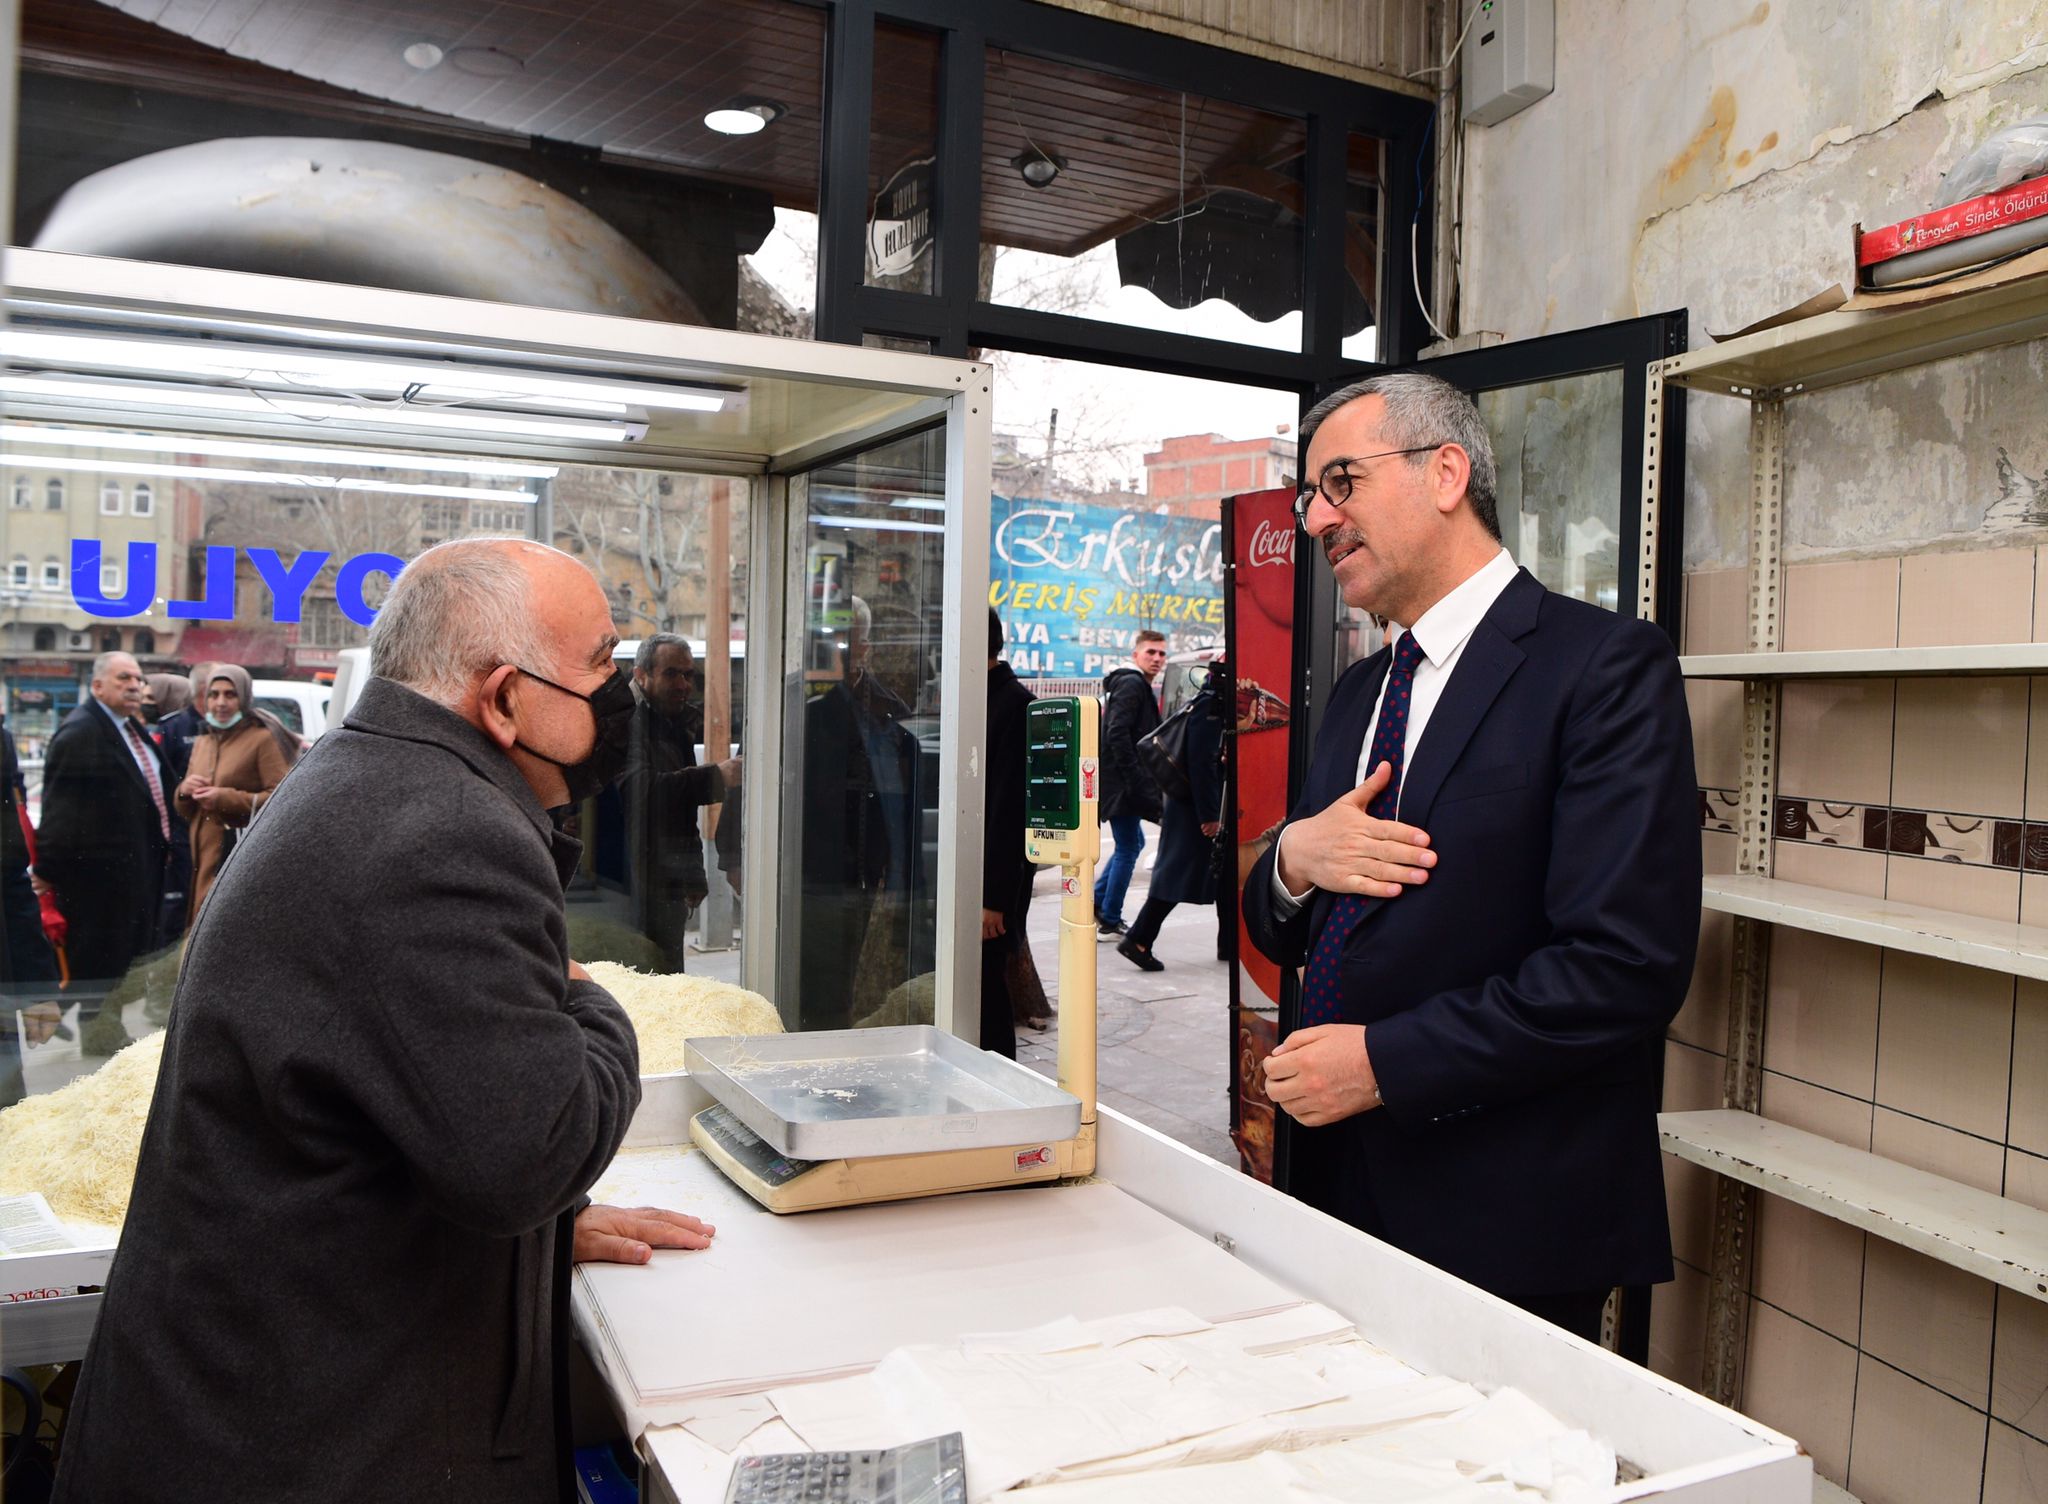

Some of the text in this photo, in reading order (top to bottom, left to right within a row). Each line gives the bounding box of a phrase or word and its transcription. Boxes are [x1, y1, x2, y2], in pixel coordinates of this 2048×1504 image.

[1916, 221, 1960, 243] Penguen
[1965, 207, 2001, 227] Sinek
[1033, 829, 1055, 840] UFKUN
